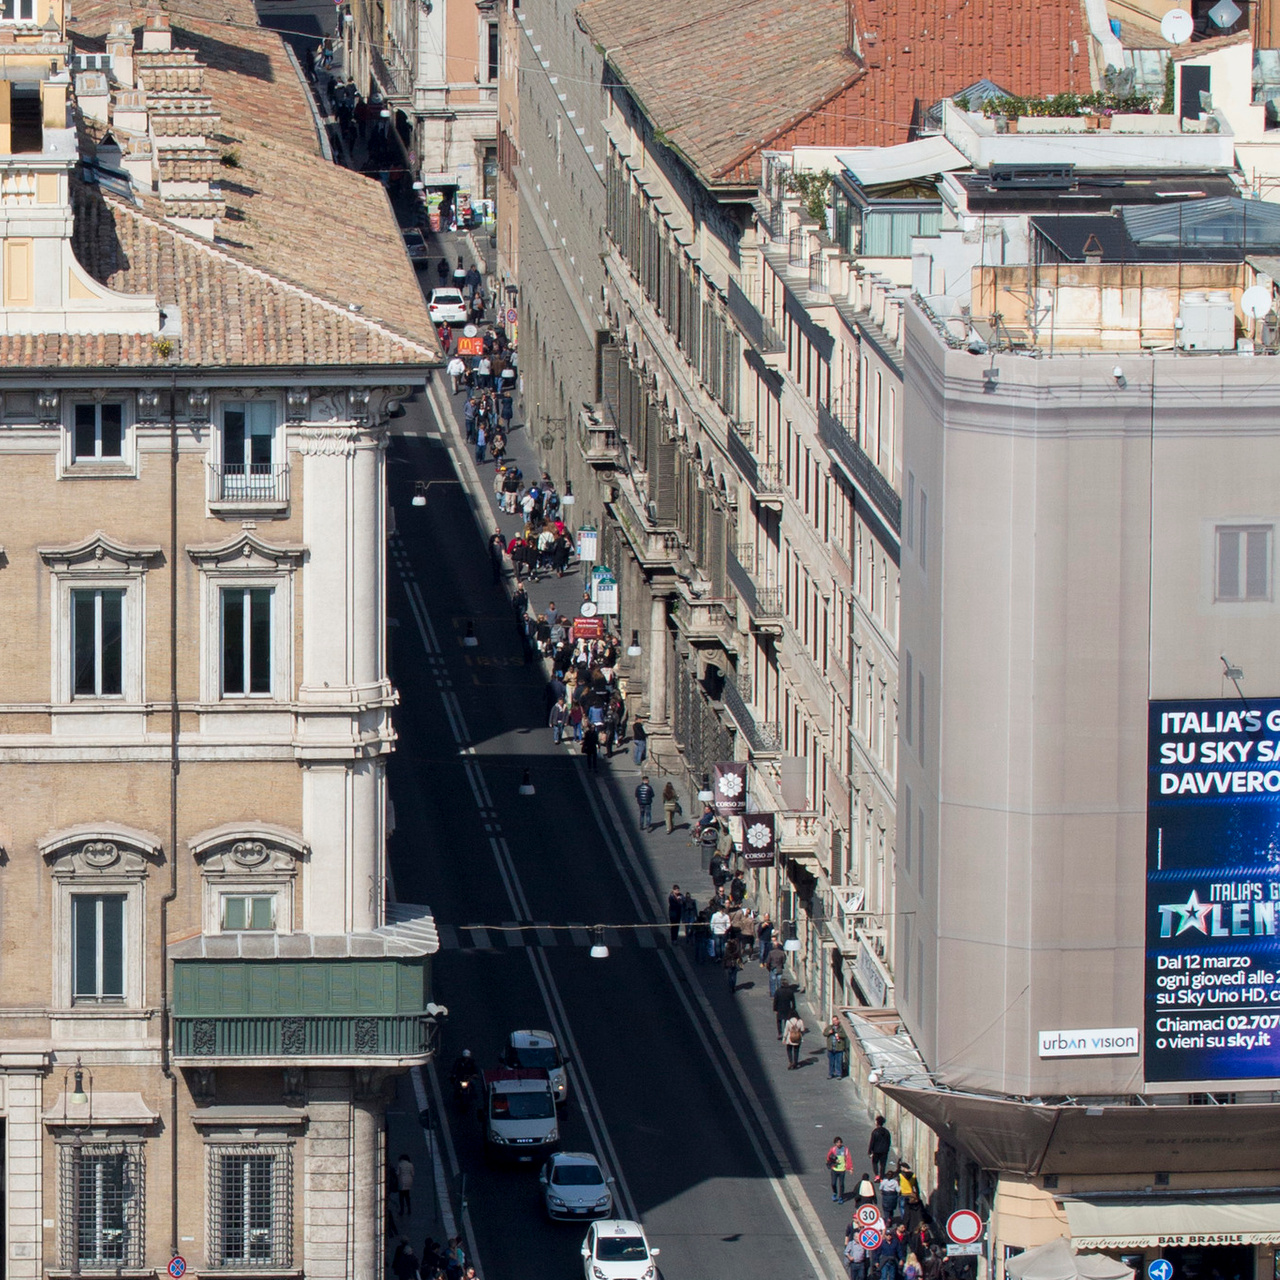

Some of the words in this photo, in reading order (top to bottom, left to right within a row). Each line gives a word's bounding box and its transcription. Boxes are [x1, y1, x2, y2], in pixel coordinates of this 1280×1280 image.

[1161, 710, 1261, 734] ITALIA'S
[1160, 741, 1195, 764] SU
[1200, 740, 1253, 763] SKY
[1160, 770, 1280, 794] DAVVERO
[1210, 883, 1262, 902] ITALIA'S
[1157, 954, 1182, 970] Dal
[1184, 954, 1201, 969] 12
[1203, 956, 1251, 969] marzo
[1156, 972, 1189, 990] ogni
[1191, 970, 1245, 989] giovedì
[1247, 970, 1274, 985] alle
[1156, 992, 1175, 1004] su
[1177, 989, 1205, 1007] Sky
[1207, 989, 1239, 1003] Uno
[1241, 988, 1268, 1004] HD,
[1156, 1016, 1224, 1032] Chiamaci
[1226, 1015, 1280, 1030] 02.707
[1156, 1037, 1167, 1049] o
[1169, 1034, 1204, 1048] vieni
[1206, 1036, 1225, 1048] su
[1227, 1031, 1271, 1050] sky.it
[862, 1210, 875, 1221] 30
[1076, 1237, 1151, 1246] Gastronomia
[1158, 1236, 1183, 1244] BAR
[1188, 1234, 1243, 1243] BRASILE
[1249, 1233, 1280, 1242] Gelat
